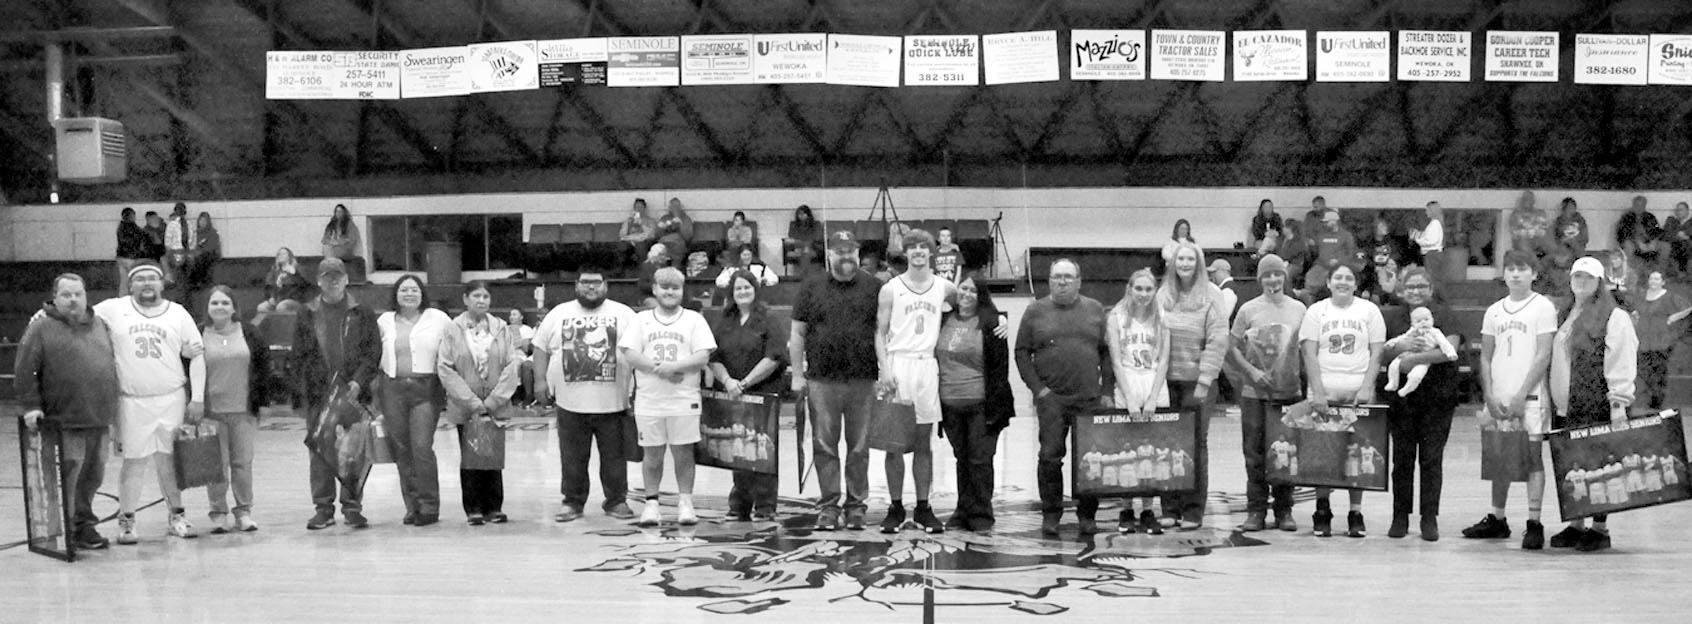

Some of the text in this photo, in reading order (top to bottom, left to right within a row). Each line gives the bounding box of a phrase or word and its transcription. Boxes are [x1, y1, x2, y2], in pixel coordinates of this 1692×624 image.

[1156, 34, 1221, 45] TOWN & COUNTRY
[1252, 35, 1302, 47] CAZADOR
[1405, 32, 1434, 43] STREATER
[1437, 33, 1457, 43] DOZER
[1490, 35, 1555, 46] GORDON COOPER
[611, 39, 677, 50] SEMINOLE
[692, 42, 745, 52] SEMINOLE
[358, 52, 399, 61] SECURITY
[908, 48, 974, 58] QUICK LUBE
[1158, 45, 1218, 57] TRACTOR SALES
[1400, 46, 1429, 56] BACKHOE
[1430, 46, 1454, 57] SERVICE
[1494, 48, 1551, 58] CAREER TECH
[290, 54, 318, 62] ALARM
[403, 53, 465, 70] Swearingen
[346, 70, 386, 79] 257-5411
[1585, 65, 1637, 75] 382-1680
[277, 76, 323, 86] 382-6106
[918, 73, 965, 82] 382-5311
[339, 80, 394, 89] 24 HOUR ATM
[563, 316, 618, 329] JOKER
[128, 323, 168, 340] FALCONS
[135, 337, 163, 360] 35
[1507, 335, 1513, 357] 1
[652, 343, 679, 363] 33
[1093, 415, 1111, 424] NEW
[1112, 415, 1131, 424] LIMA
[1569, 428, 1588, 440] NEW
[1589, 424, 1611, 437] LIMA
